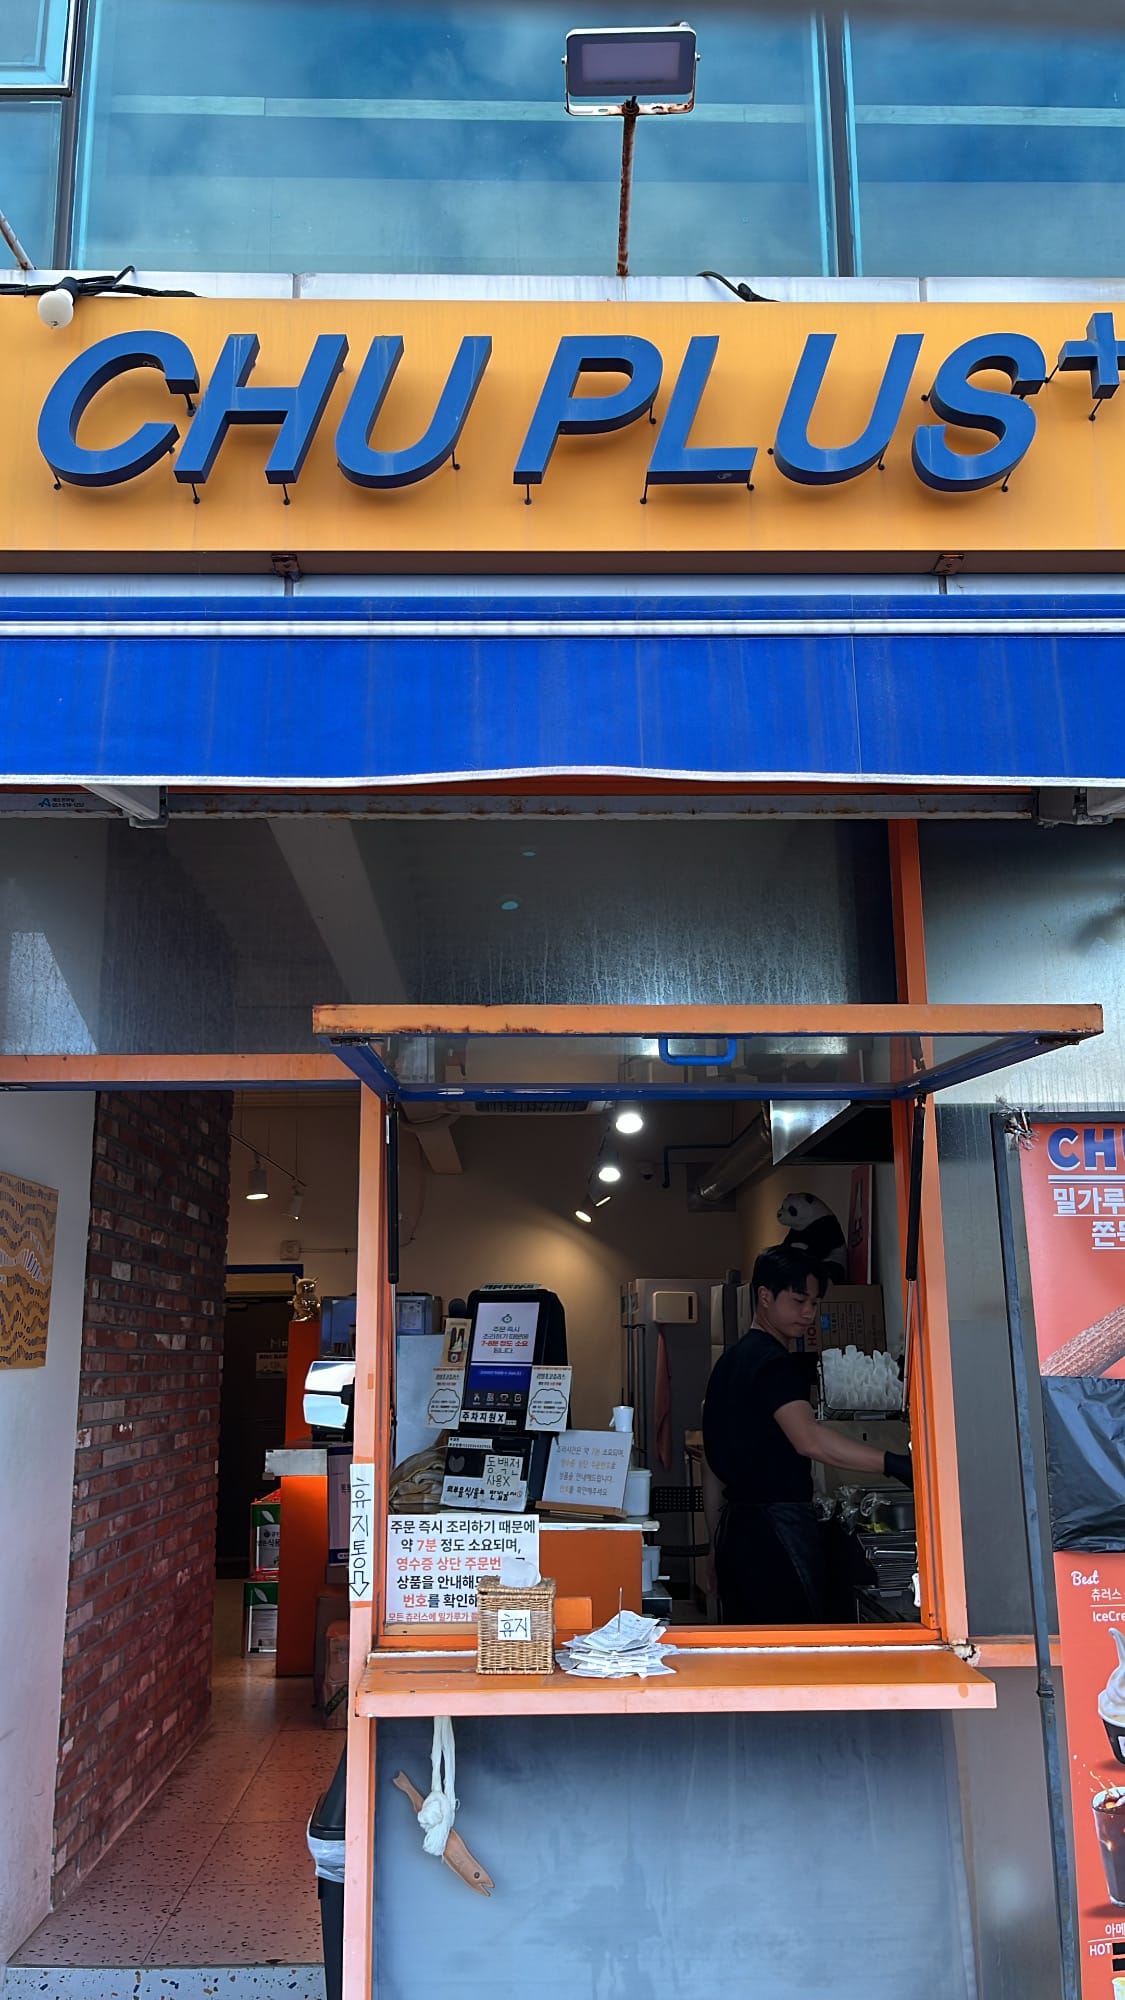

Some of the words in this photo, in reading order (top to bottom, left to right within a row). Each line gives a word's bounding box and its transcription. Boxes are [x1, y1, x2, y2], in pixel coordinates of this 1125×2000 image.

[37, 329, 492, 489] CHU
[1047, 1127, 1125, 1171] CH
[487, 1456, 520, 1476] 동백전
[351, 1477, 371, 1569] 휴지통
[390, 1520, 415, 1534] 주문
[418, 1520, 443, 1534] 즉시
[446, 1520, 495, 1534] 조리하기
[499, 1520, 535, 1534] 때문에
[400, 1538, 413, 1552] 약
[416, 1538, 437, 1552] 7분
[440, 1538, 465, 1552] 정도
[468, 1538, 521, 1554] 소요되며,
[396, 1556, 433, 1571] 영수증
[437, 1556, 461, 1571] 상단
[397, 1575, 434, 1590] 상품을
[1071, 1569, 1100, 1586] Best
[403, 1593, 440, 1608] 번호를
[1091, 1587, 1123, 1602] 츄러스
[388, 1612, 404, 1622] 모든
[438, 1612, 468, 1622] 밀가루가
[499, 1613, 528, 1638] 휴지
[1089, 1942, 1112, 1957] HOT
